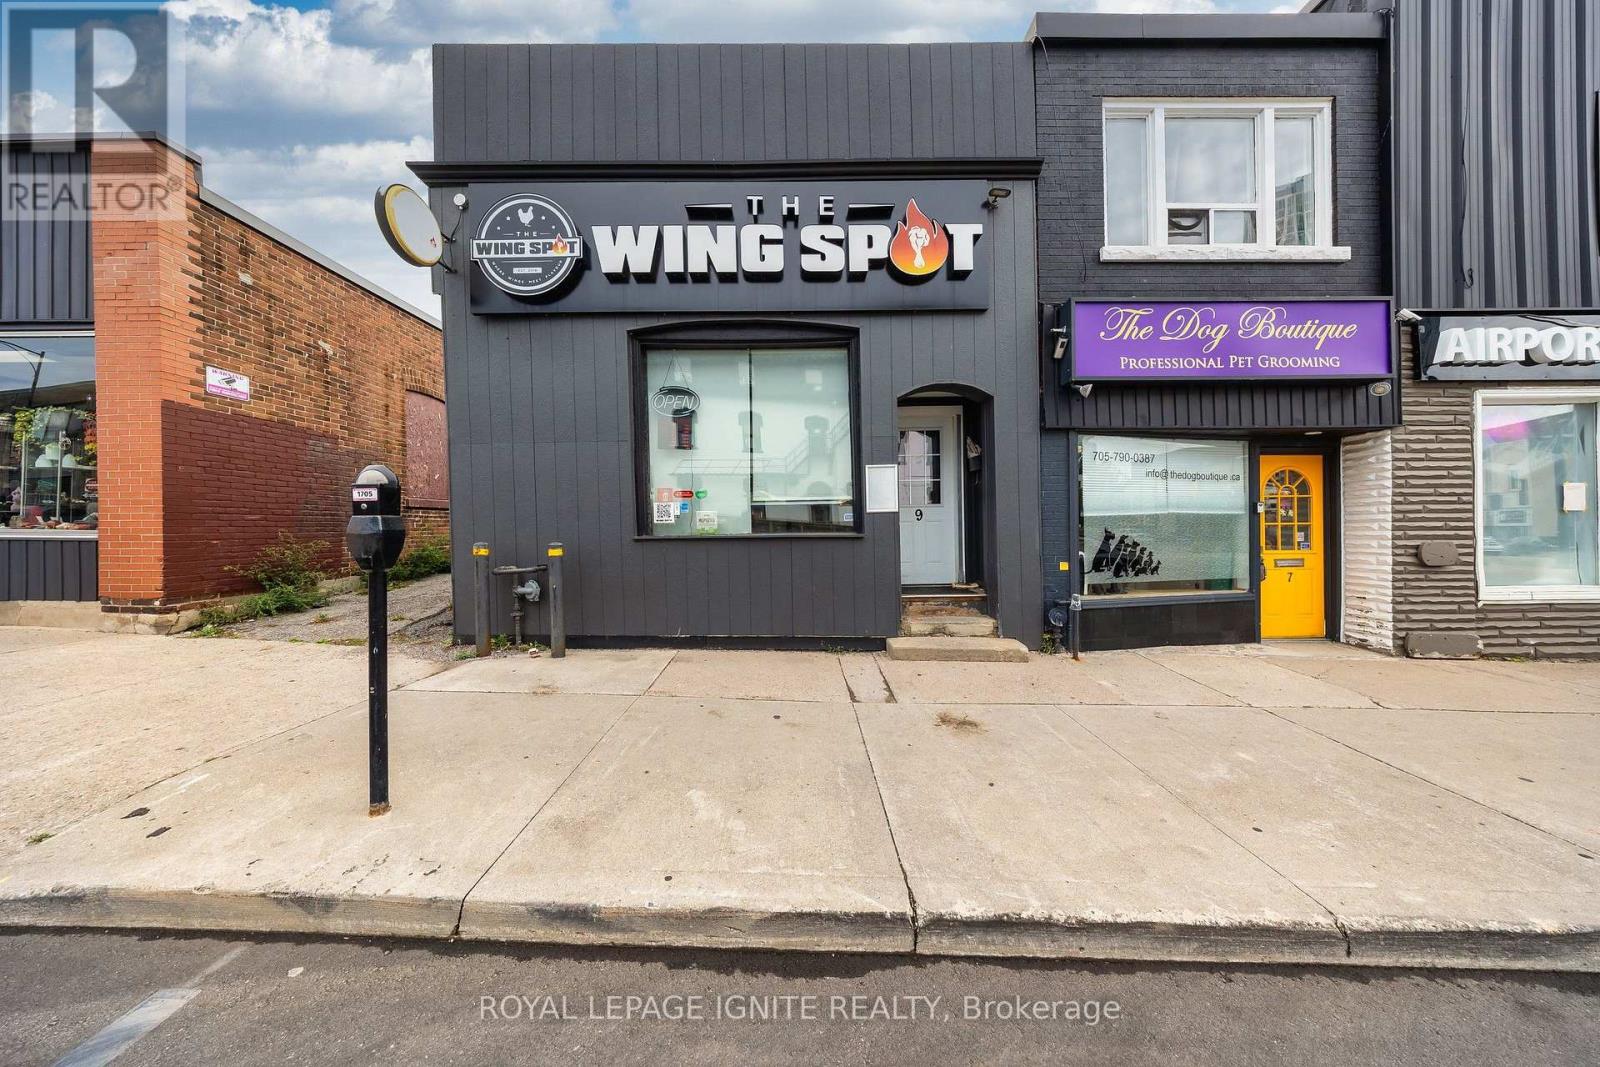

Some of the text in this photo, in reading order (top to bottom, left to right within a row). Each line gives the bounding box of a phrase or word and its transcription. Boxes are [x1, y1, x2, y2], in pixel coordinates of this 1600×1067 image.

[746, 196, 835, 216] THE
[475, 242, 526, 256] WING
[591, 225, 785, 274] WING
[1099, 306, 1359, 354] The Dog Boutique
[1433, 326, 1600, 364] AIRPOR
[653, 394, 695, 410] OPEN
[1092, 451, 1156, 464] 705-790-0387
[357, 490, 373, 498] 1705
[914, 508, 924, 522] 9
[1287, 572, 1294, 582] 7
